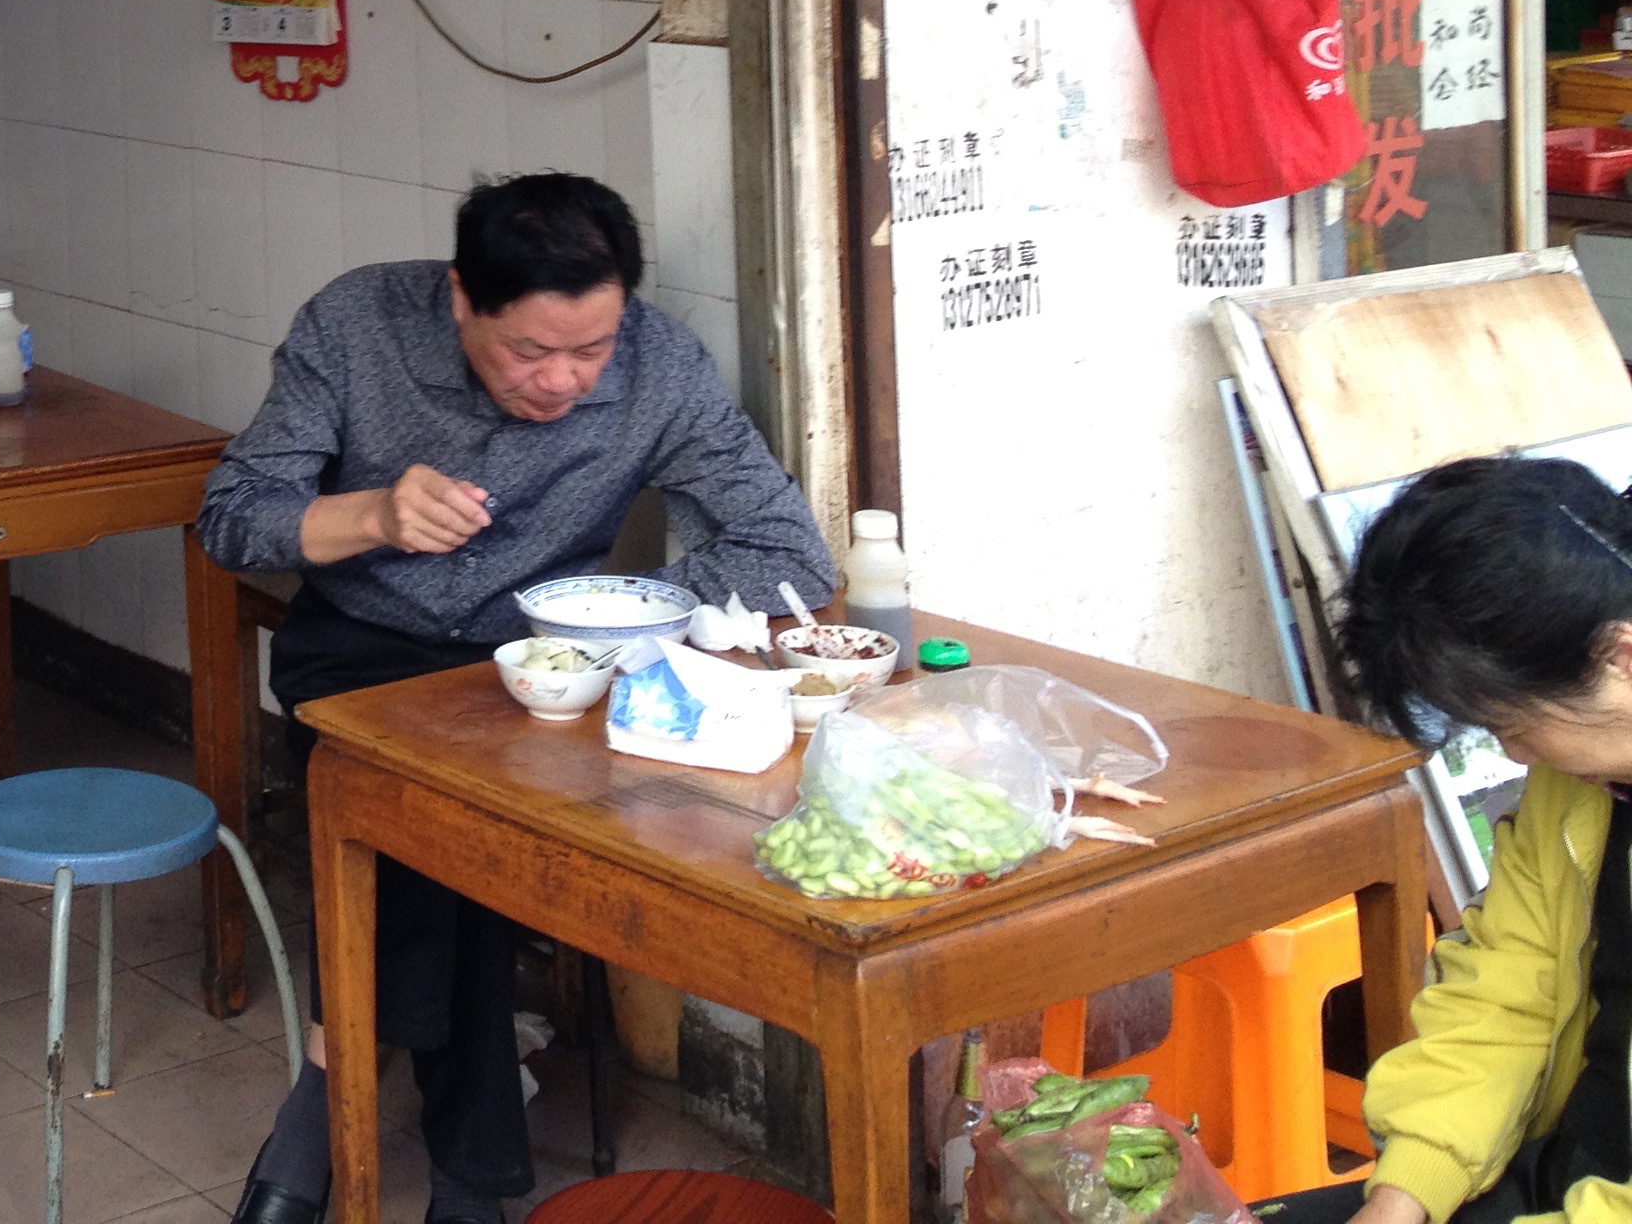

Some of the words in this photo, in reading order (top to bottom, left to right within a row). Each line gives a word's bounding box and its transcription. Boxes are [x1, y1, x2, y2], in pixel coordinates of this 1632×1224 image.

[1175, 212, 1267, 240] 办证刻章
[939, 239, 1039, 283] 办证刻章
[940, 272, 1042, 333] 13127528971
